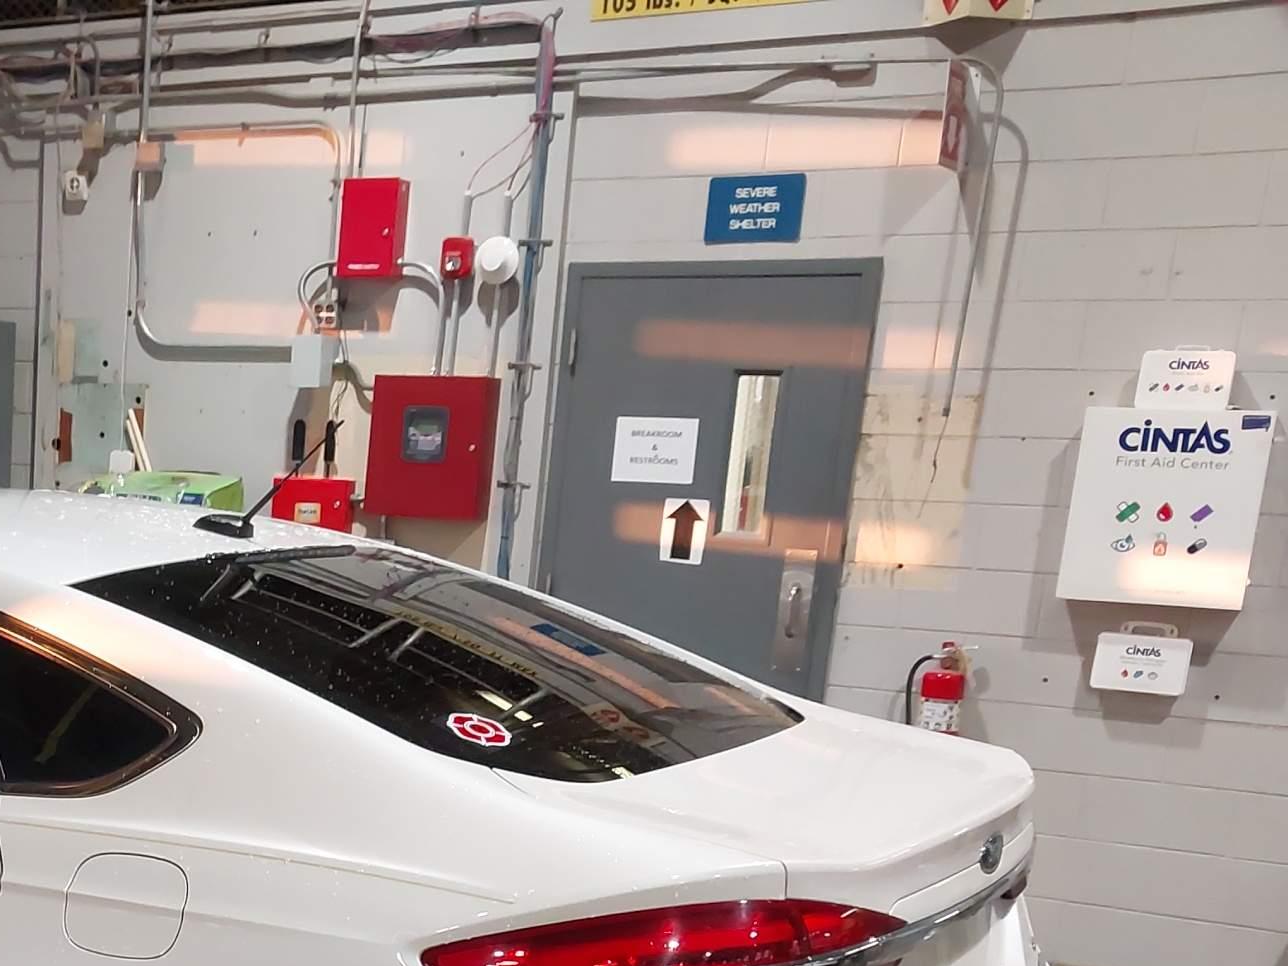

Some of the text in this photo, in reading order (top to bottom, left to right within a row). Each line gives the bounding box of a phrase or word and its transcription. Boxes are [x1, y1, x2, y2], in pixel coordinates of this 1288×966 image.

[735, 186, 778, 198] SEVERE
[729, 202, 781, 214] WEATHER
[729, 218, 776, 230] SHELTER
[631, 430, 683, 438] BREAKROOM
[629, 456, 678, 465] RESTROOMS
[1115, 455, 1230, 470] First Aid Center
